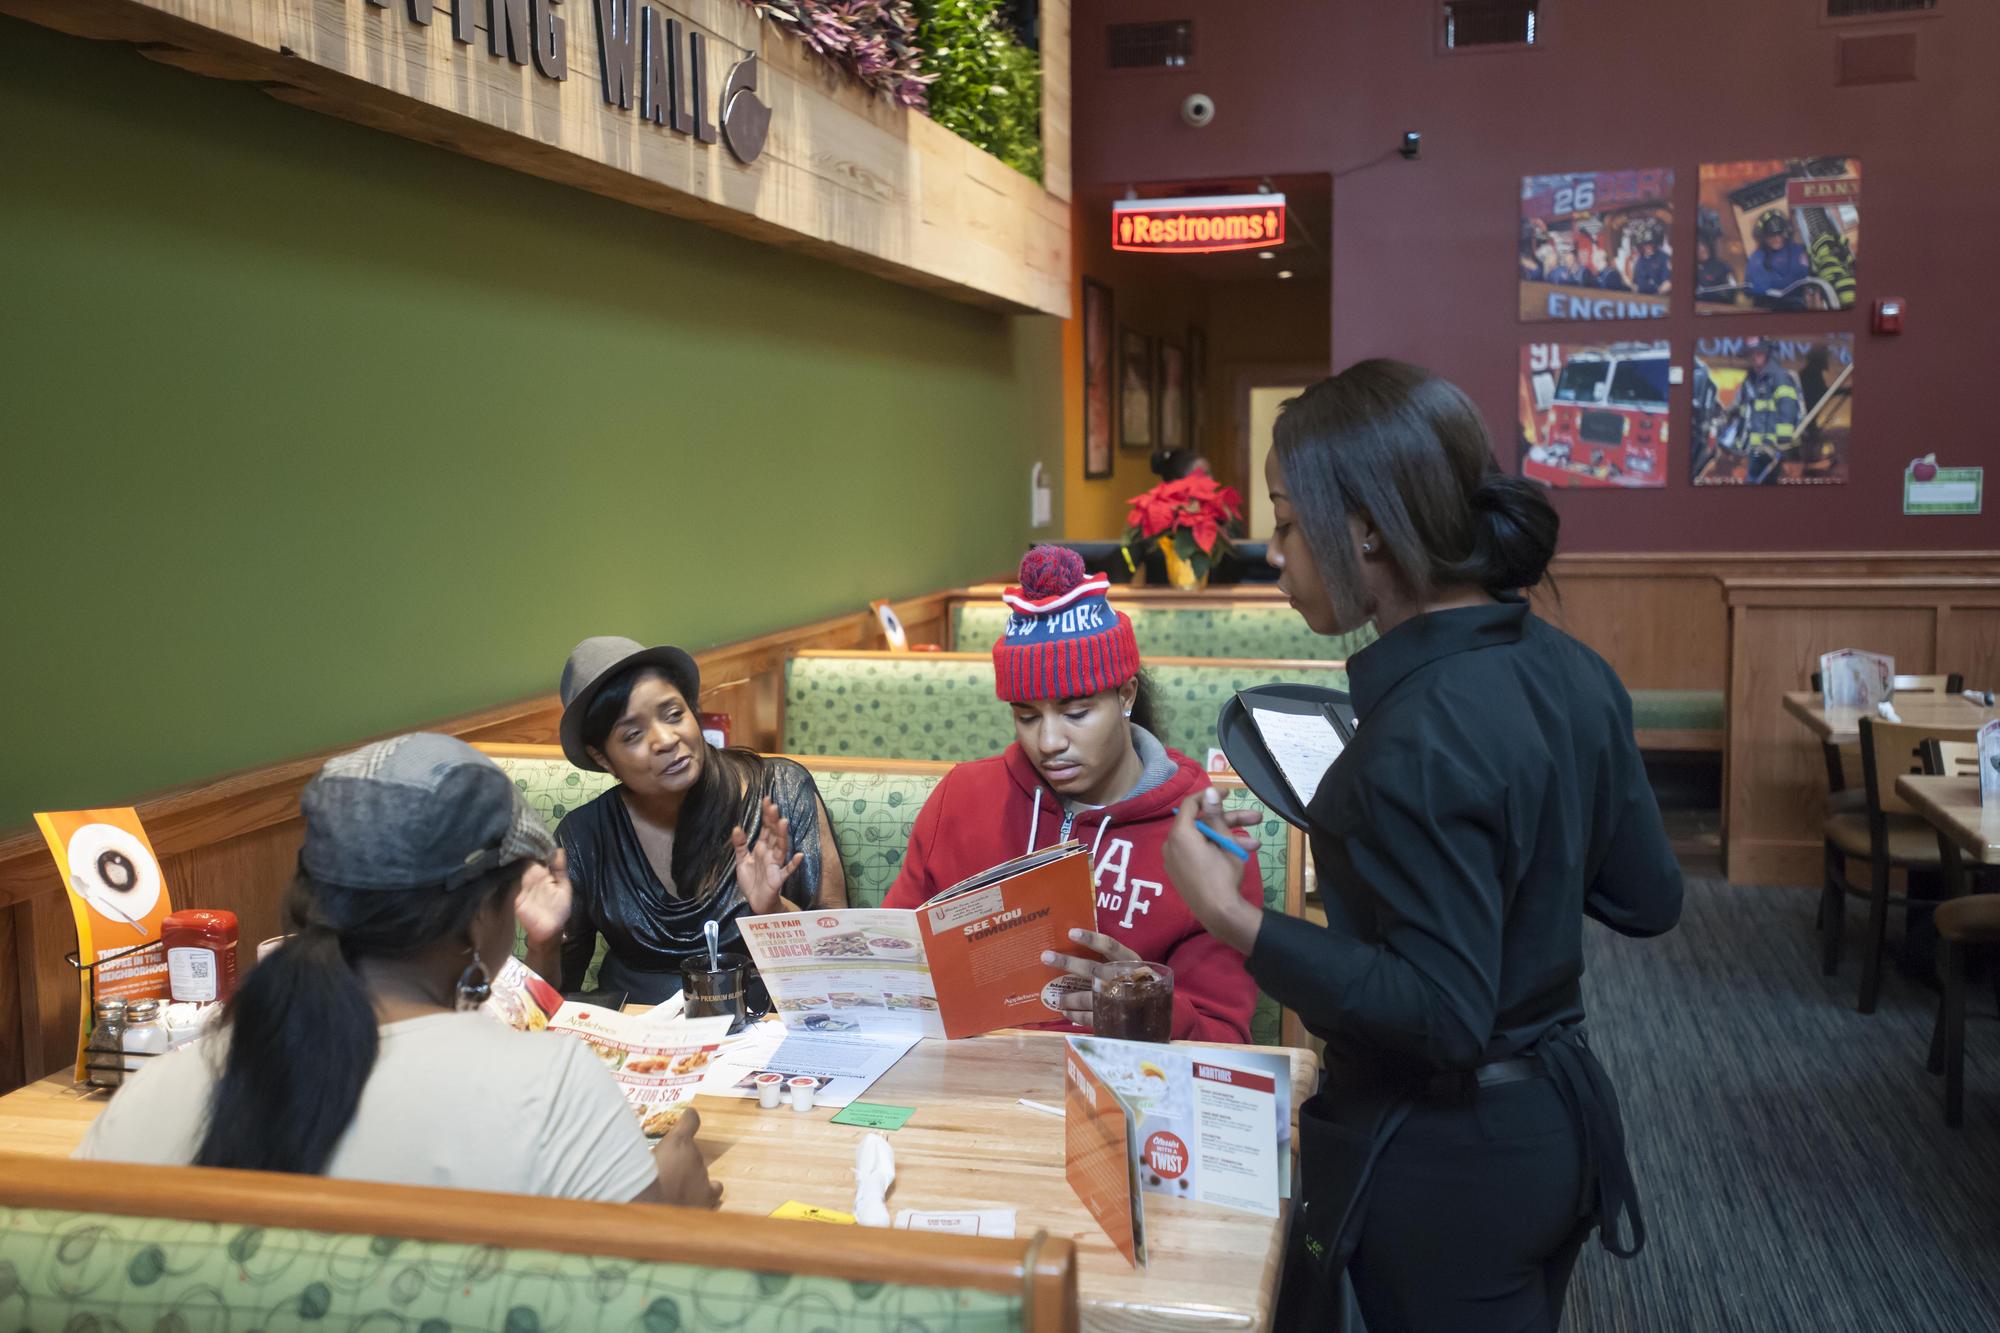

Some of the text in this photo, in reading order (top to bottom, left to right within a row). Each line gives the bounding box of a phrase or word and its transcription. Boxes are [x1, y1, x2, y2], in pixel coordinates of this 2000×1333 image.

[593, 0, 716, 144] WALL
[1553, 181, 1595, 215] 26
[1132, 213, 1264, 244] Restrooms
[1047, 604, 1104, 634] YORK
[1094, 838, 1134, 893] A
[1097, 891, 1122, 911] ND
[1119, 878, 1163, 929] F
[748, 922, 769, 931] PICK
[782, 919, 801, 928] PAIR
[767, 930, 793, 939] WAYS
[794, 929, 806, 937] TO
[963, 908, 1022, 936] SEE YOU
[964, 906, 1051, 944] TOMORROW
[760, 943, 814, 960] LUNCH
[700, 993, 728, 1002] PREMIUM
[624, 1087, 682, 1102] 2 FOR $26
[1150, 1150, 1183, 1174] TWIST
